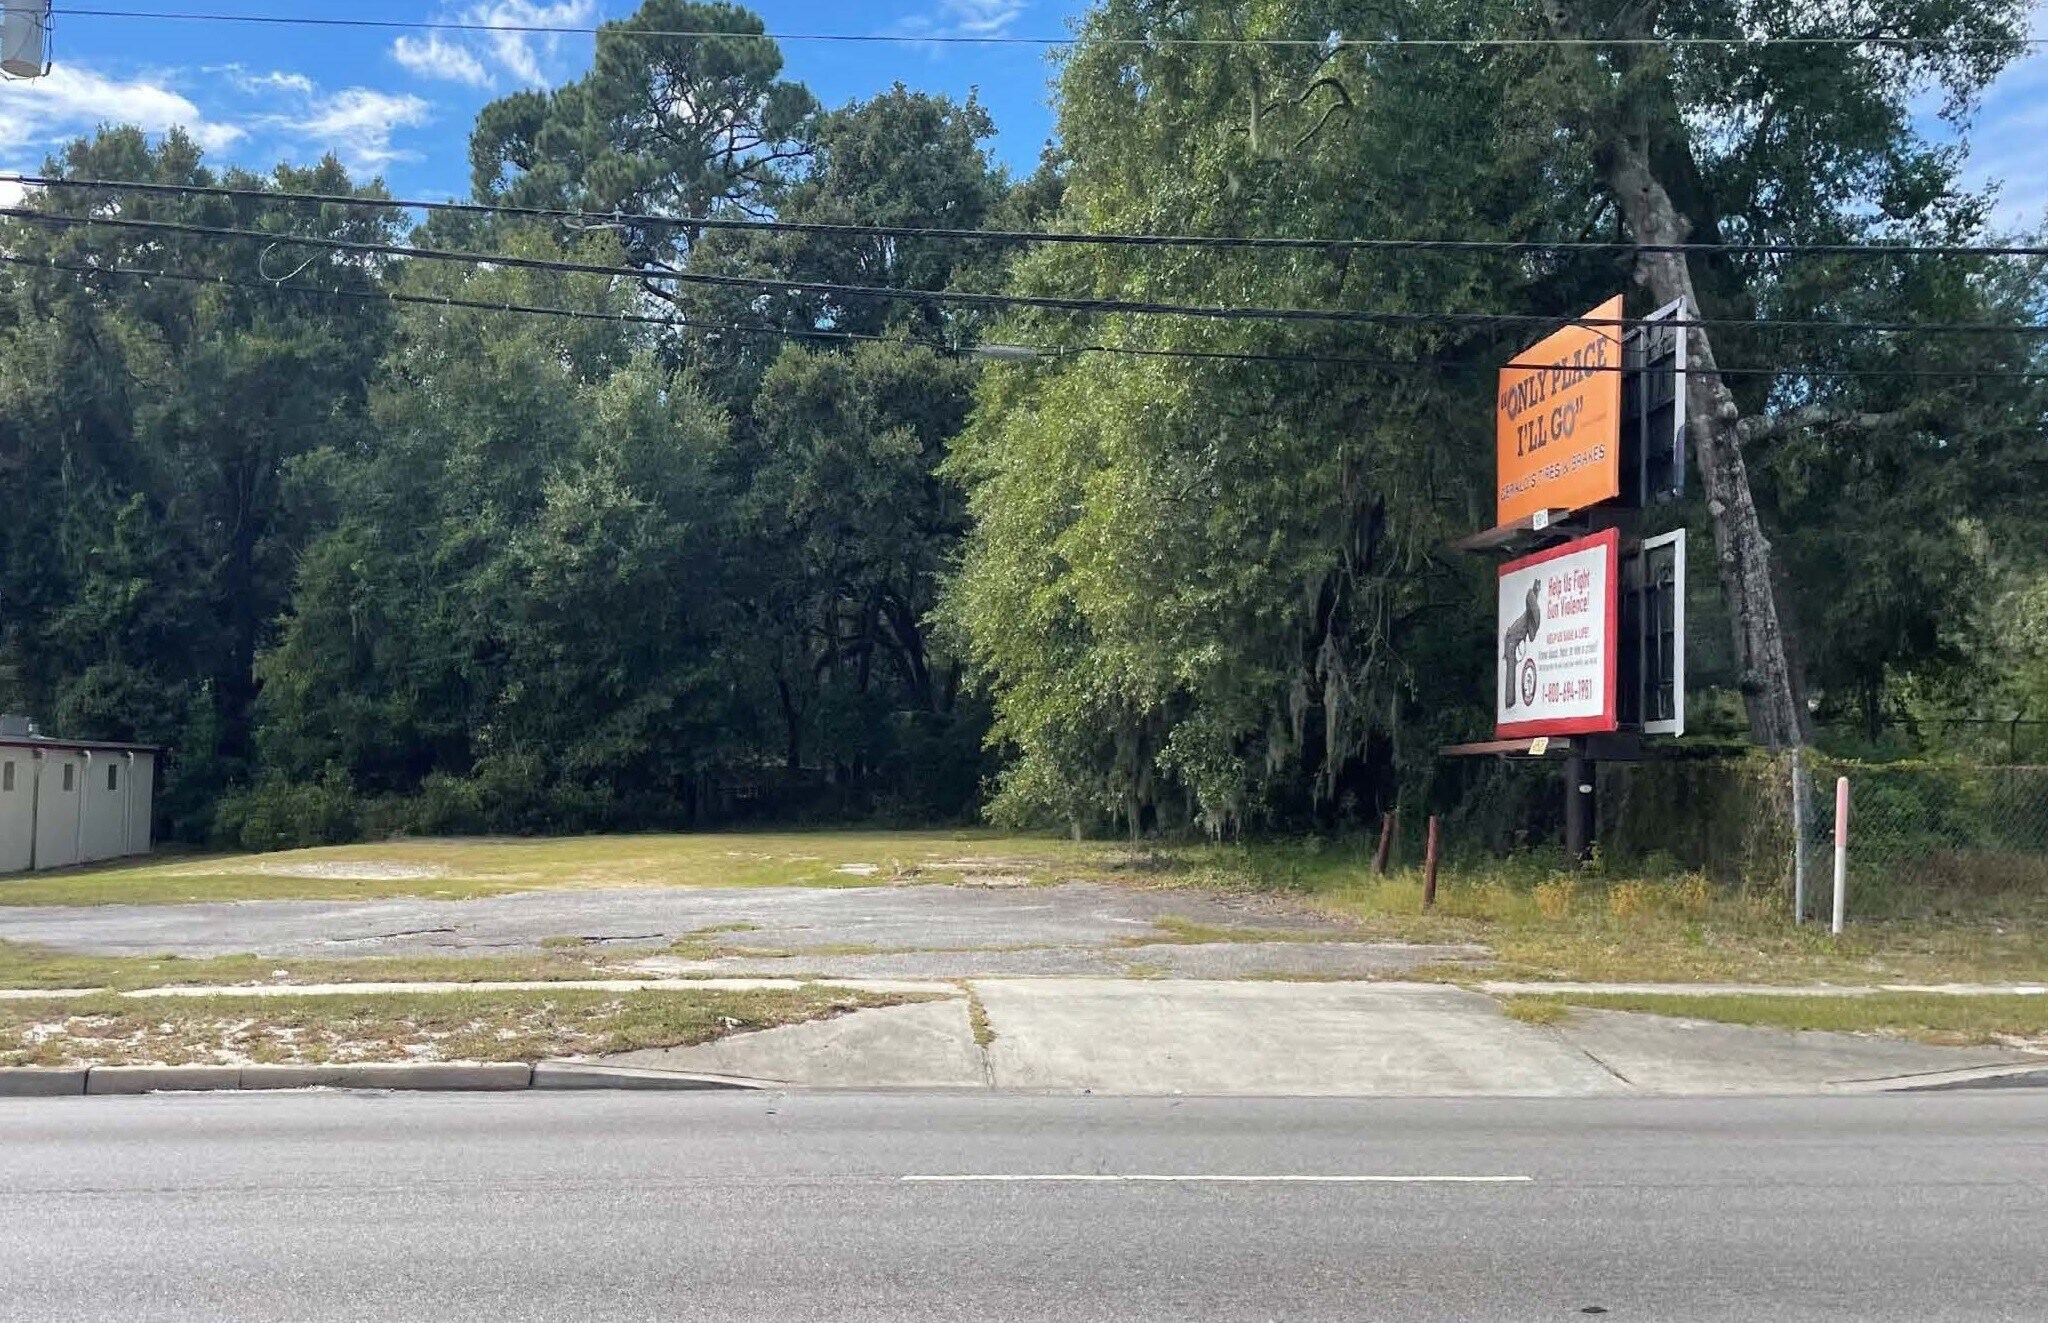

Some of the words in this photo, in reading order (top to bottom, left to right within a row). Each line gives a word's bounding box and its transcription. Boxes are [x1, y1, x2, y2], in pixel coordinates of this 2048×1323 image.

[1501, 368, 1548, 420] "ONLY
[1551, 337, 1607, 396] PLACE
[1517, 415, 1547, 457] I'LL
[1551, 395, 1584, 440] GO"
[1571, 444, 1606, 471] BRAKES
[1548, 576, 1562, 598] Help
[1563, 573, 1572, 593] Us
[1574, 568, 1590, 595] Fight
[1547, 600, 1559, 619] Gun
